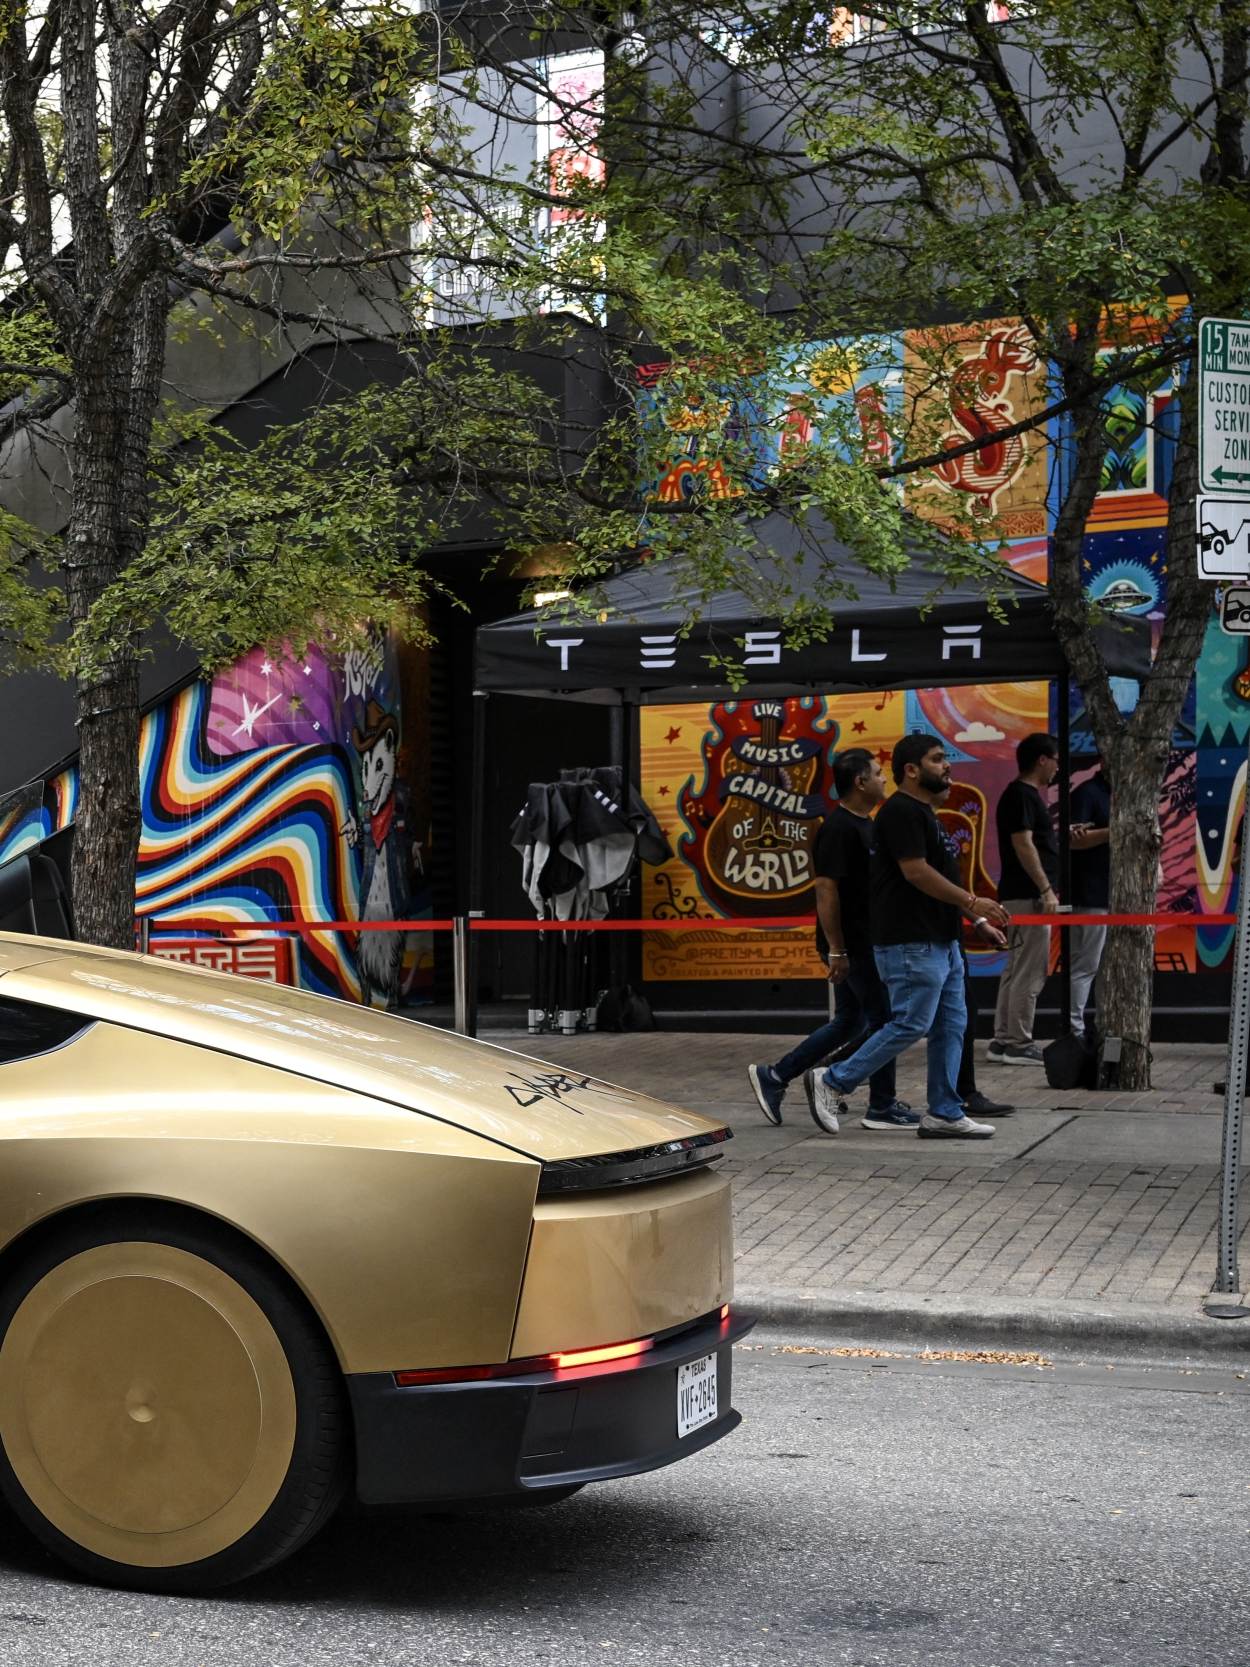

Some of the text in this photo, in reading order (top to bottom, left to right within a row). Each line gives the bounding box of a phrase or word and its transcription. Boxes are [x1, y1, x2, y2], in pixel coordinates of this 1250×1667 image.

[1206, 324, 1223, 353] 15
[1205, 353, 1223, 370] MIN
[1208, 381, 1250, 405] CUSTO
[1224, 438, 1250, 461] ZON
[546, 625, 982, 671] TESLA
[753, 702, 783, 718] LIVE
[740, 741, 804, 763] MUSIC
[728, 775, 808, 815] CAPITAL
[733, 817, 808, 841] OF THE
[723, 847, 810, 891] WORLD
[746, 933, 782, 941] FOLLOW
[670, 968, 710, 977] CREATED
[722, 968, 761, 977] PAINTED
[763, 967, 775, 976] BY
[691, 1359, 706, 1377] TEXAS
